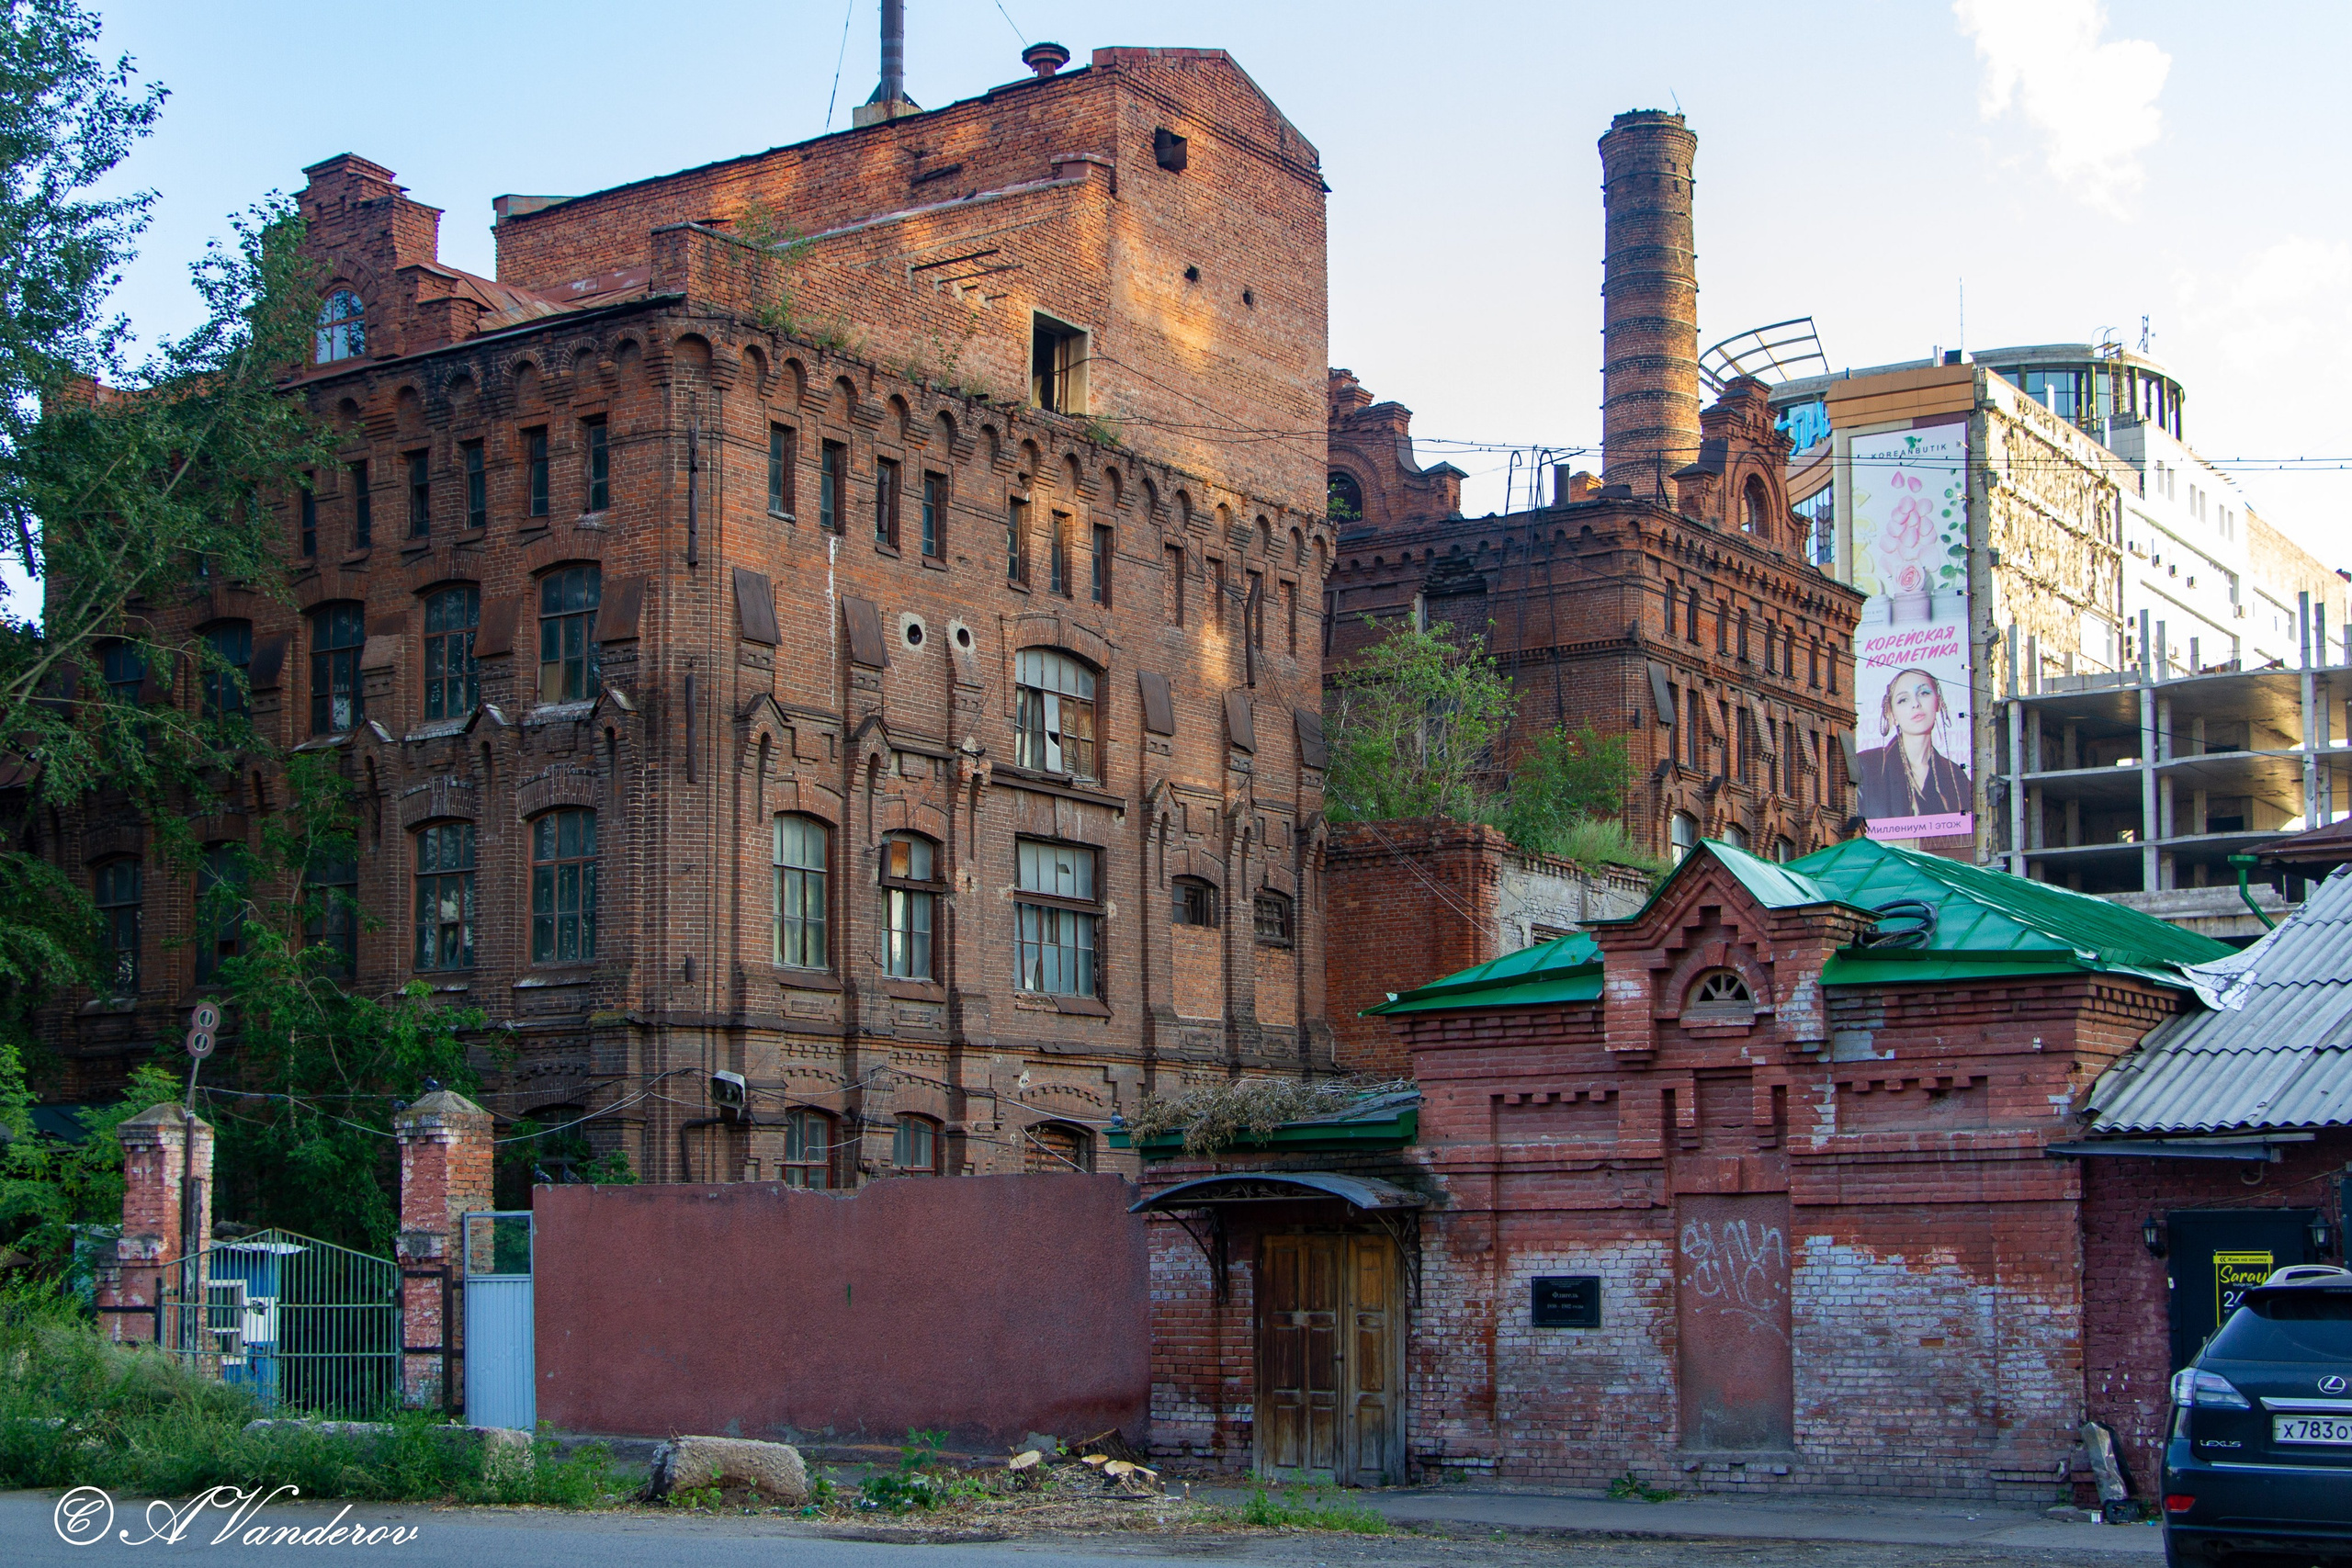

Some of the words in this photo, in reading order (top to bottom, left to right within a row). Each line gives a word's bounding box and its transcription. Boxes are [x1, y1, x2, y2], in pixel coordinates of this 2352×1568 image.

[1871, 443, 1947, 459] KOREANBUTIK
[1864, 626, 1955, 652] КОРЕЙСКАЯ
[1865, 642, 1959, 670] КОСМЕТИКА
[1867, 825, 1927, 834] Миллениум
[1935, 820, 1961, 830] этаж
[2220, 1265, 2267, 1286] Saray
[1552, 1291, 1579, 1299] Флигель
[2199, 1439, 2242, 1448] LEXUS
